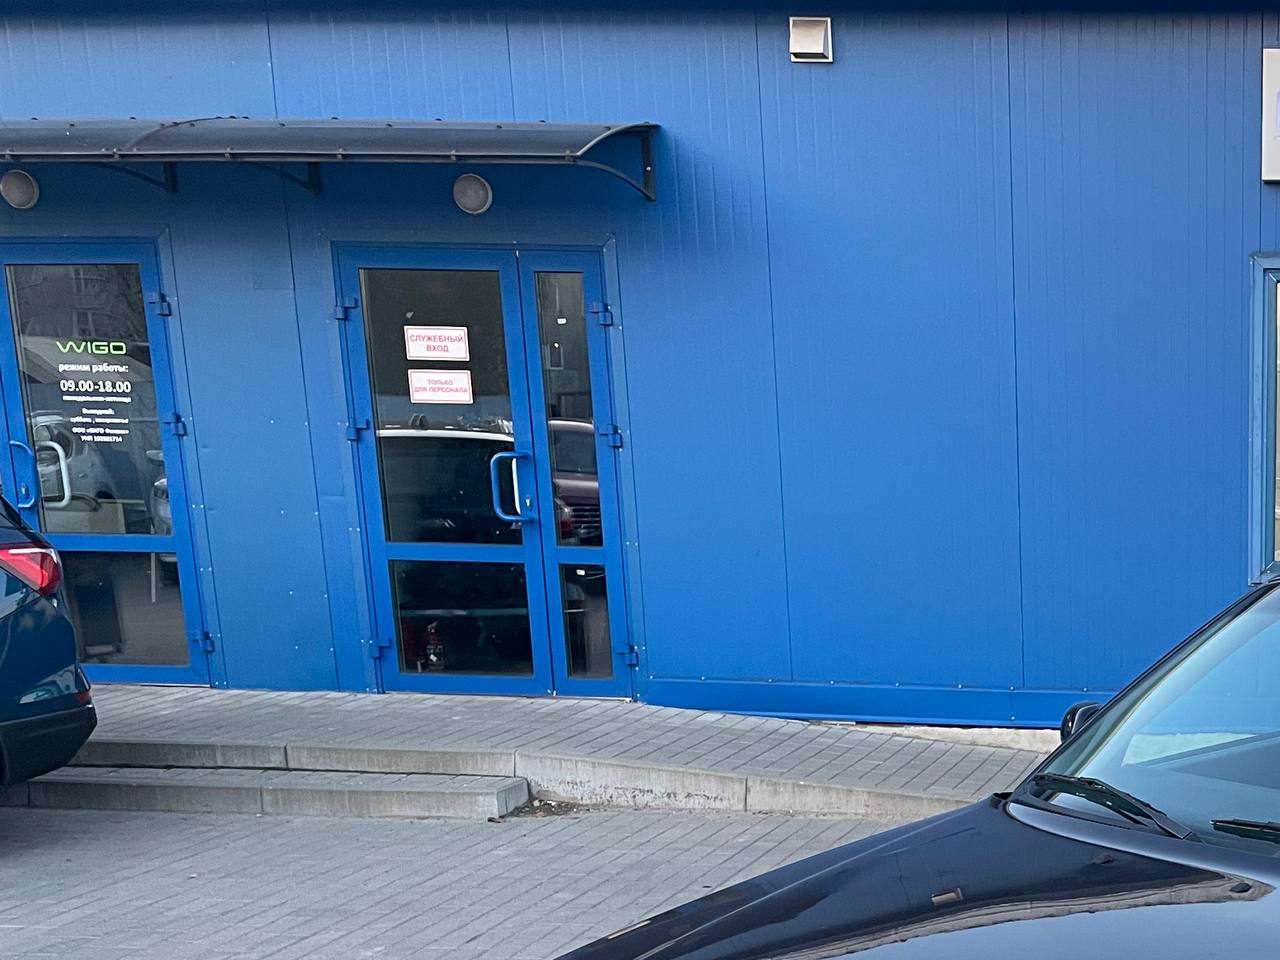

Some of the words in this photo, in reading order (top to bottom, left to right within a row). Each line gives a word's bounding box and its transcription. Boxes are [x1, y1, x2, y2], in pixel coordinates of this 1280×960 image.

[409, 334, 464, 343] СЛУЖЕБНЫЙ
[56, 341, 127, 355] WIGO
[426, 344, 449, 353] ВХОД
[58, 363, 91, 373] режим
[91, 362, 129, 374] работы:
[60, 380, 132, 393] 09.00-18.00
